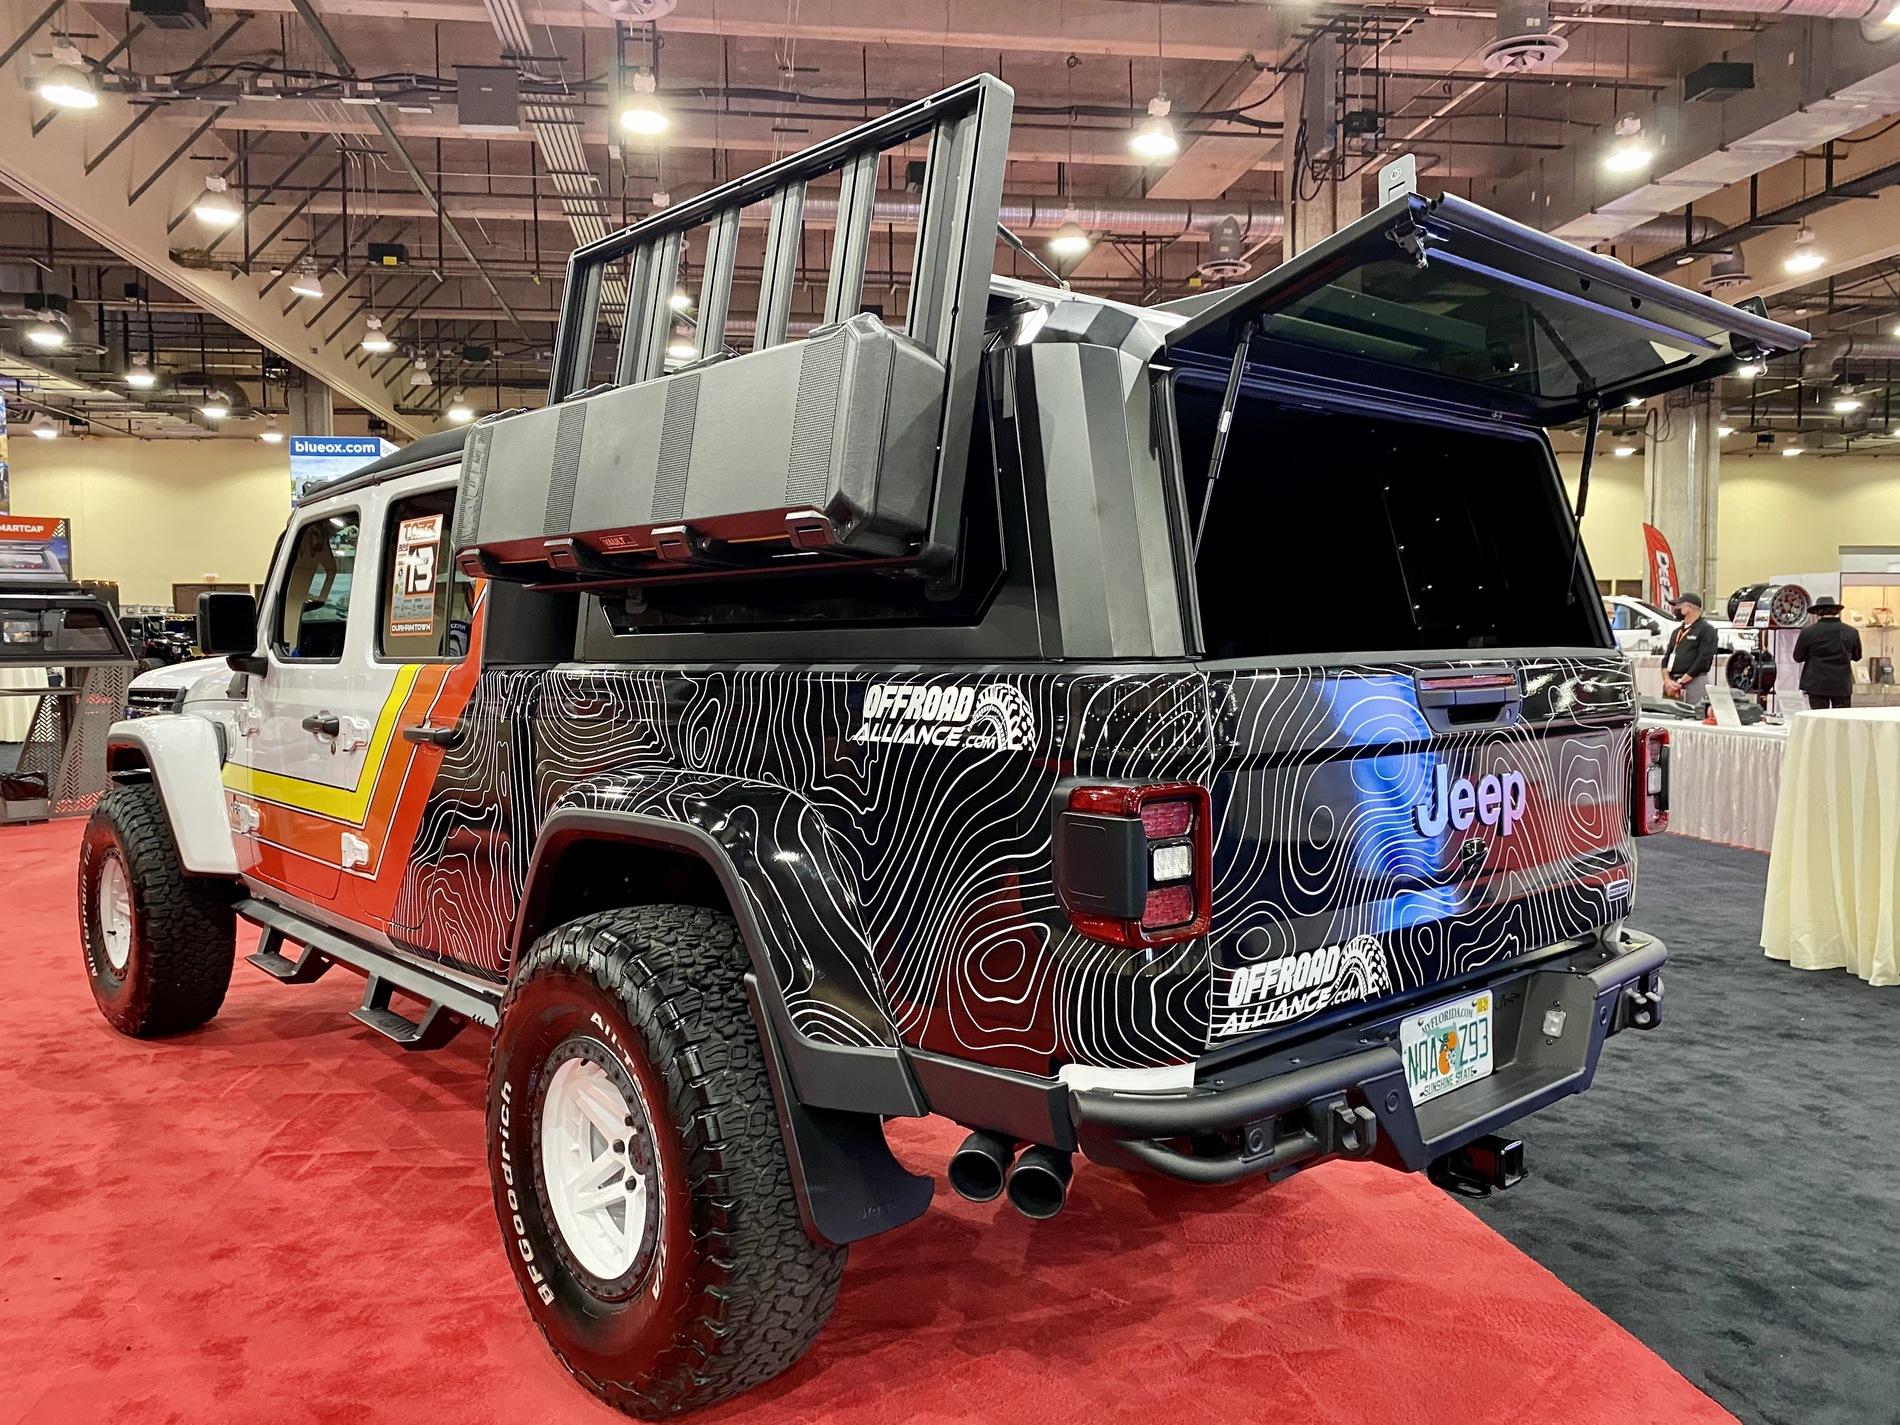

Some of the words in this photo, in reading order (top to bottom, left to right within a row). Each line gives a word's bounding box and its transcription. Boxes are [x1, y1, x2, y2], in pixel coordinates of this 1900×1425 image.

[295, 440, 375, 453] blueox.com
[602, 536, 626, 547] VAULT
[391, 622, 431, 632] DURHAMTOWN
[863, 684, 975, 722] OFFROAD
[1412, 762, 1526, 838] Jeep
[1228, 944, 1341, 1007] OFFROAD
[1408, 1037, 1438, 1089] NQA
[1459, 1017, 1489, 1067] Z93
[1424, 1074, 1453, 1096] SUNSHINE
[1455, 1066, 1474, 1083] STATE
[499, 1081, 555, 1306] BFGoodrich
